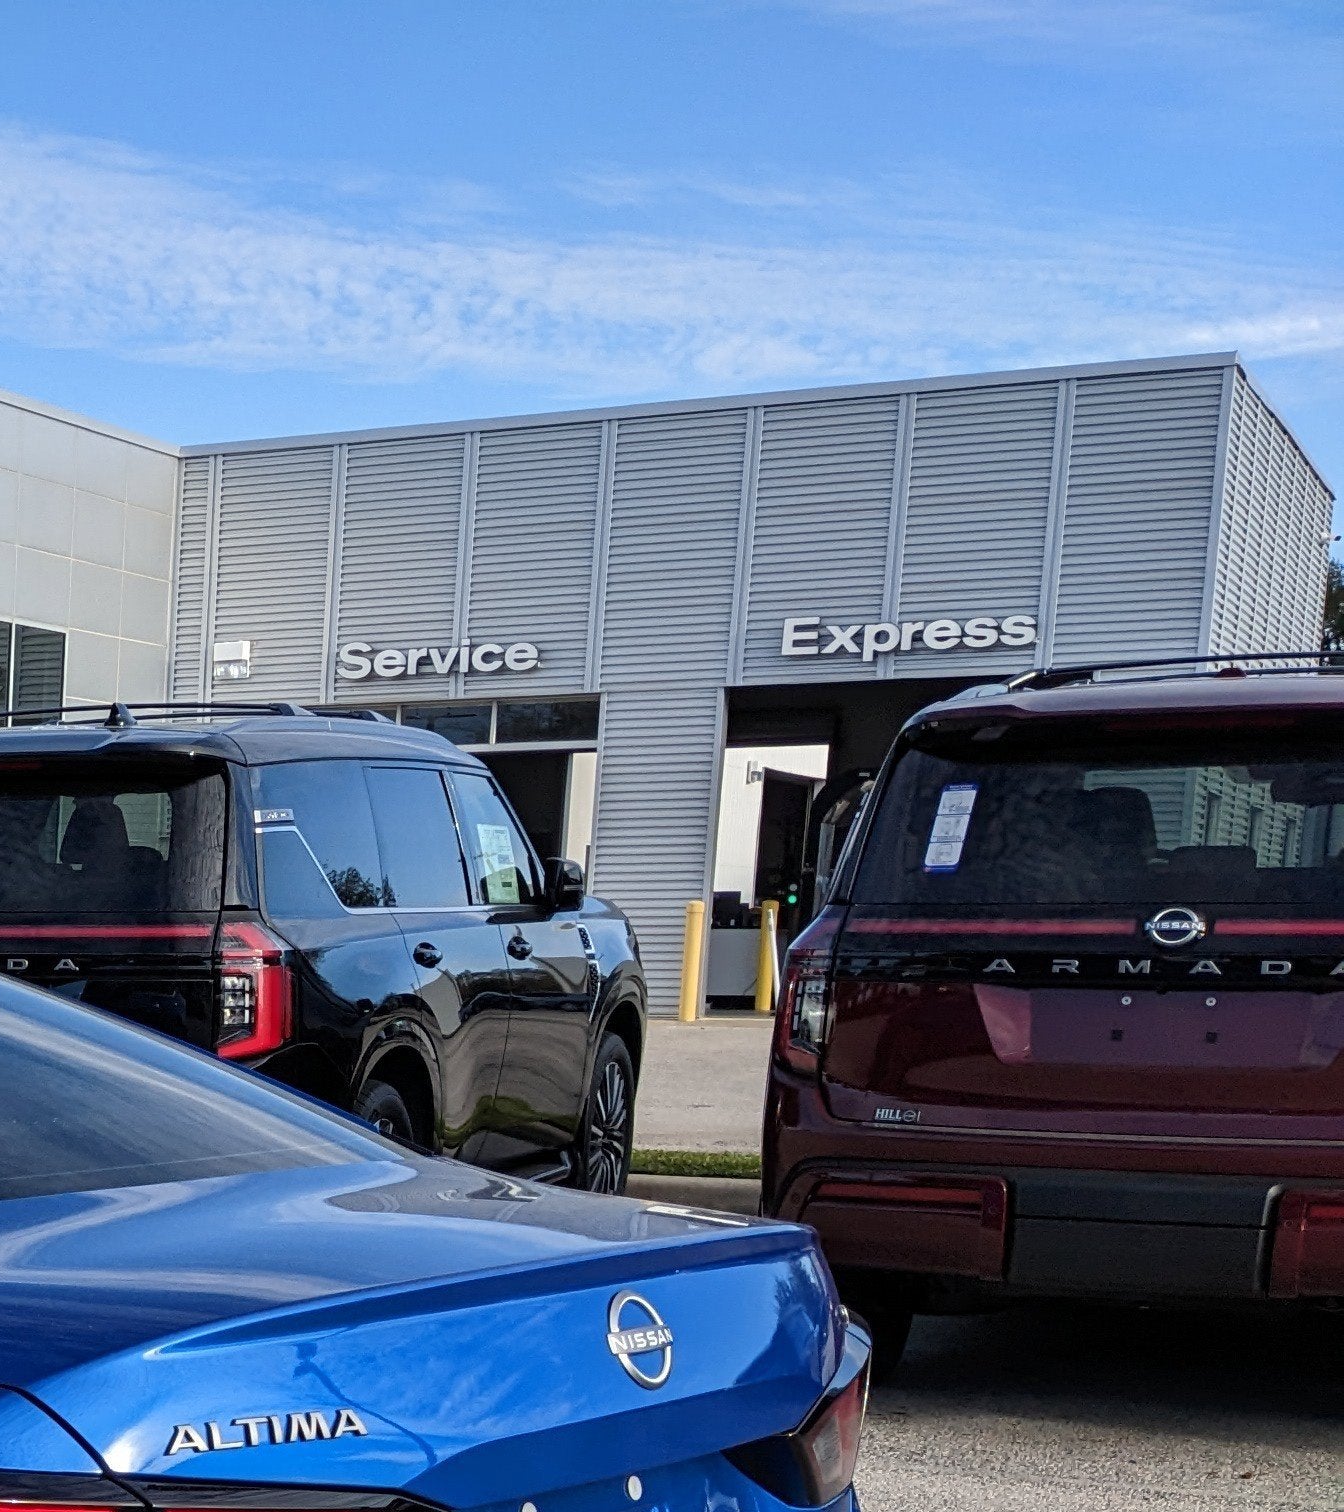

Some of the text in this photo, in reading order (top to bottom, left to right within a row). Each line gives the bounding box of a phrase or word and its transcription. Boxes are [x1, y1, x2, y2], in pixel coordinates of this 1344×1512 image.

[781, 614, 1038, 662] Express
[336, 638, 540, 680] Service
[1143, 920, 1205, 931] NISSAN
[875, 1108, 902, 1120] HILL
[611, 1325, 675, 1354] NISSAN
[163, 1408, 370, 1457] ALTIMA
